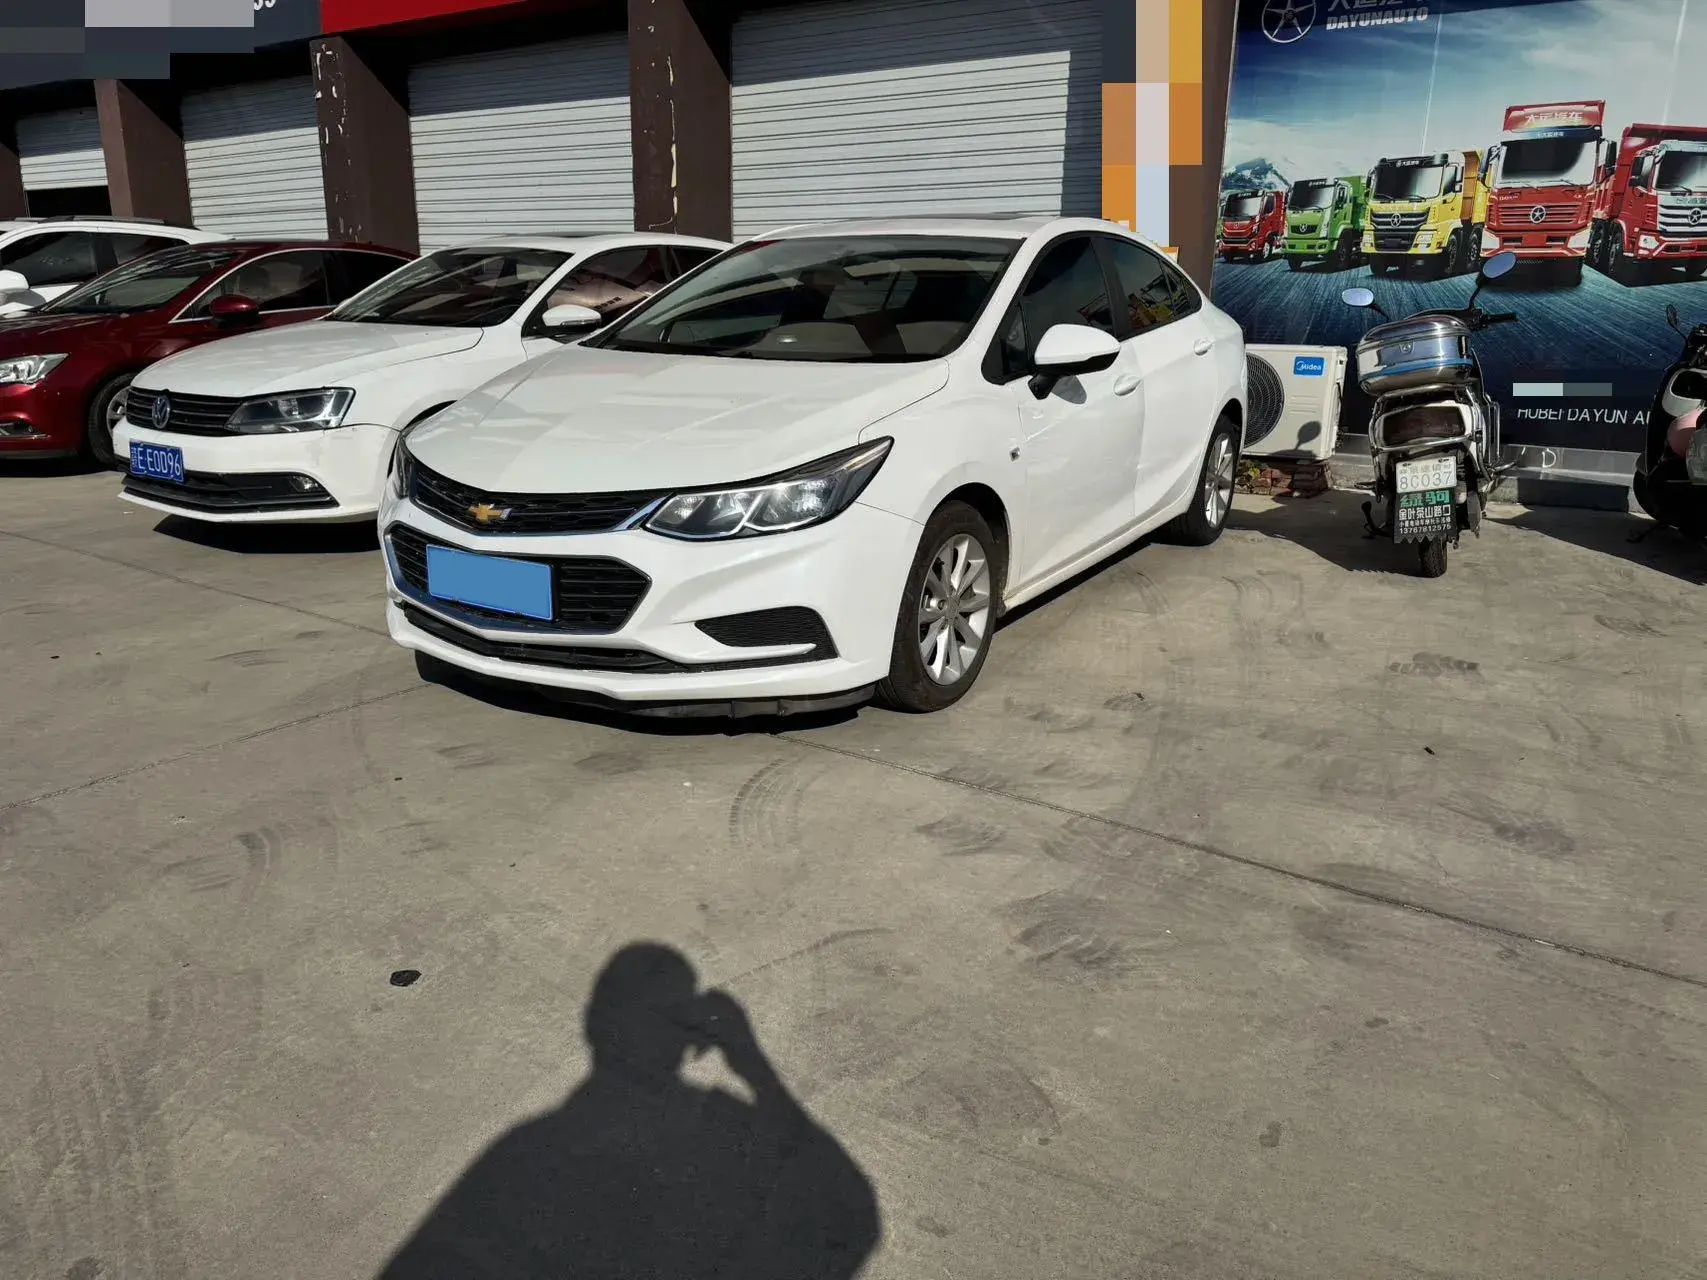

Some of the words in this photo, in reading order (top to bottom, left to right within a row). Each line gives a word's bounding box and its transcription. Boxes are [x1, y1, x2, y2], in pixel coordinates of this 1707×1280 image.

[1326, 7, 1429, 30] DAYUNAUTO
[1298, 361, 1322, 371] Midea
[1567, 408, 1628, 424] DAYUN
[1399, 504, 1451, 521] 金叶茶山路口
